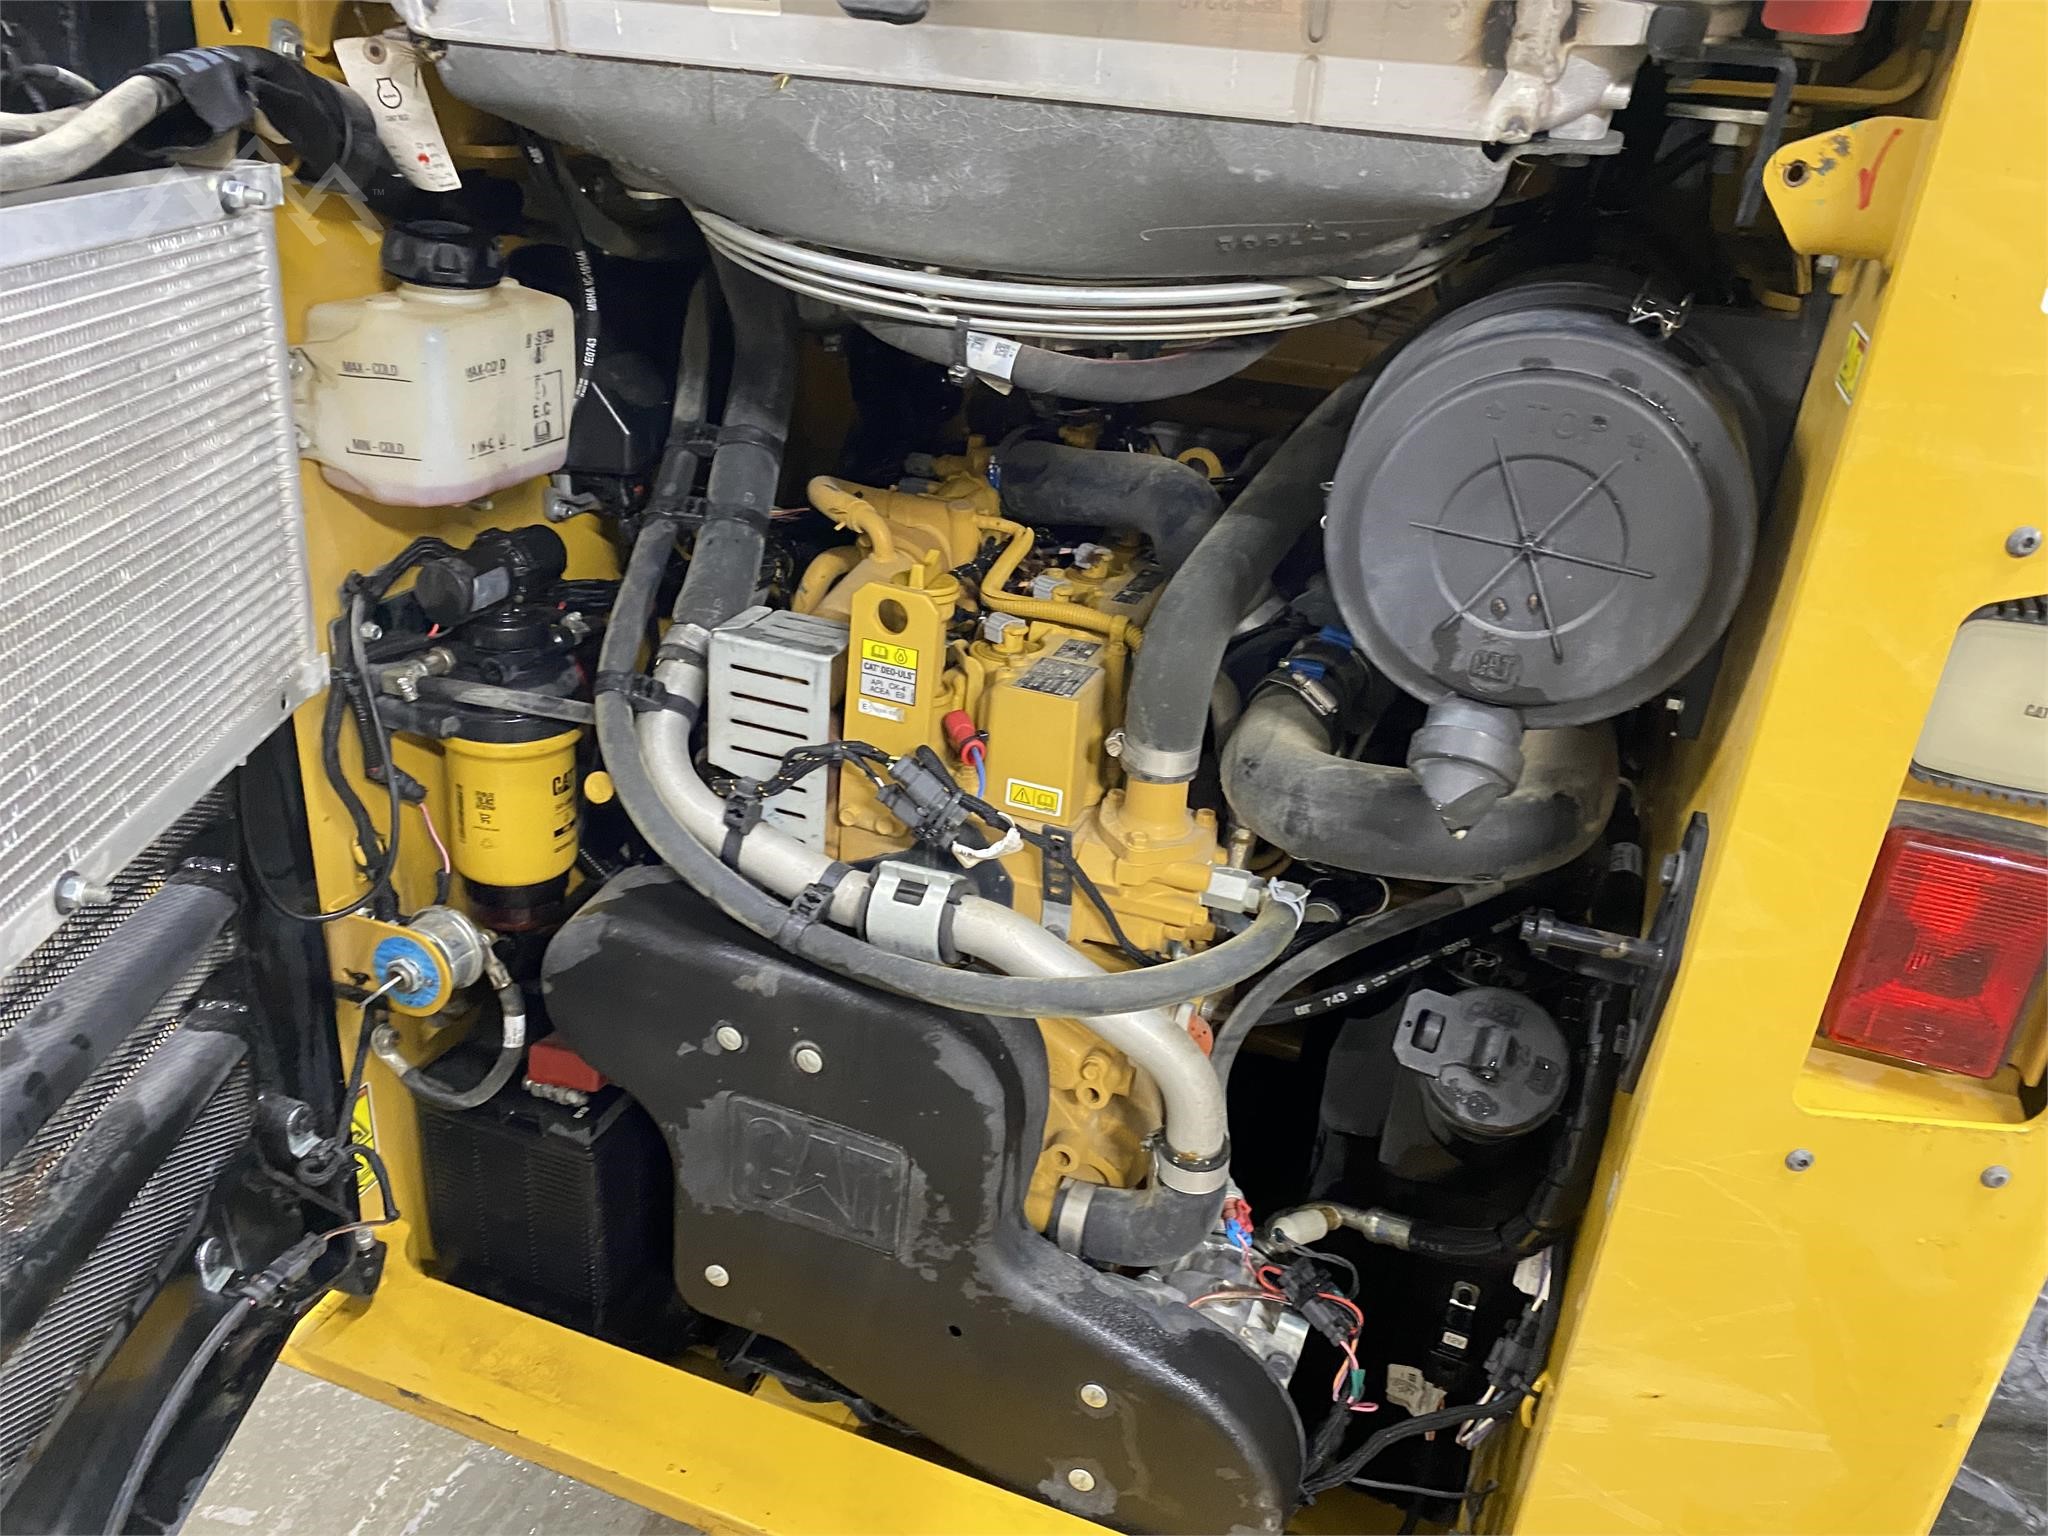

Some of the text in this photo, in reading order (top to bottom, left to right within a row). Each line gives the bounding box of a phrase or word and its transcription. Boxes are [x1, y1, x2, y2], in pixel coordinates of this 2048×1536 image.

[585, 287, 598, 311] MSHA
[584, 337, 598, 367] 1E0743
[342, 360, 364, 374] MAX
[372, 361, 399, 377] COLD
[352, 438, 373, 451] MIN
[378, 440, 405, 455] COLD
[1470, 650, 1522, 684] CAT
[1322, 991, 1349, 1008] 743
